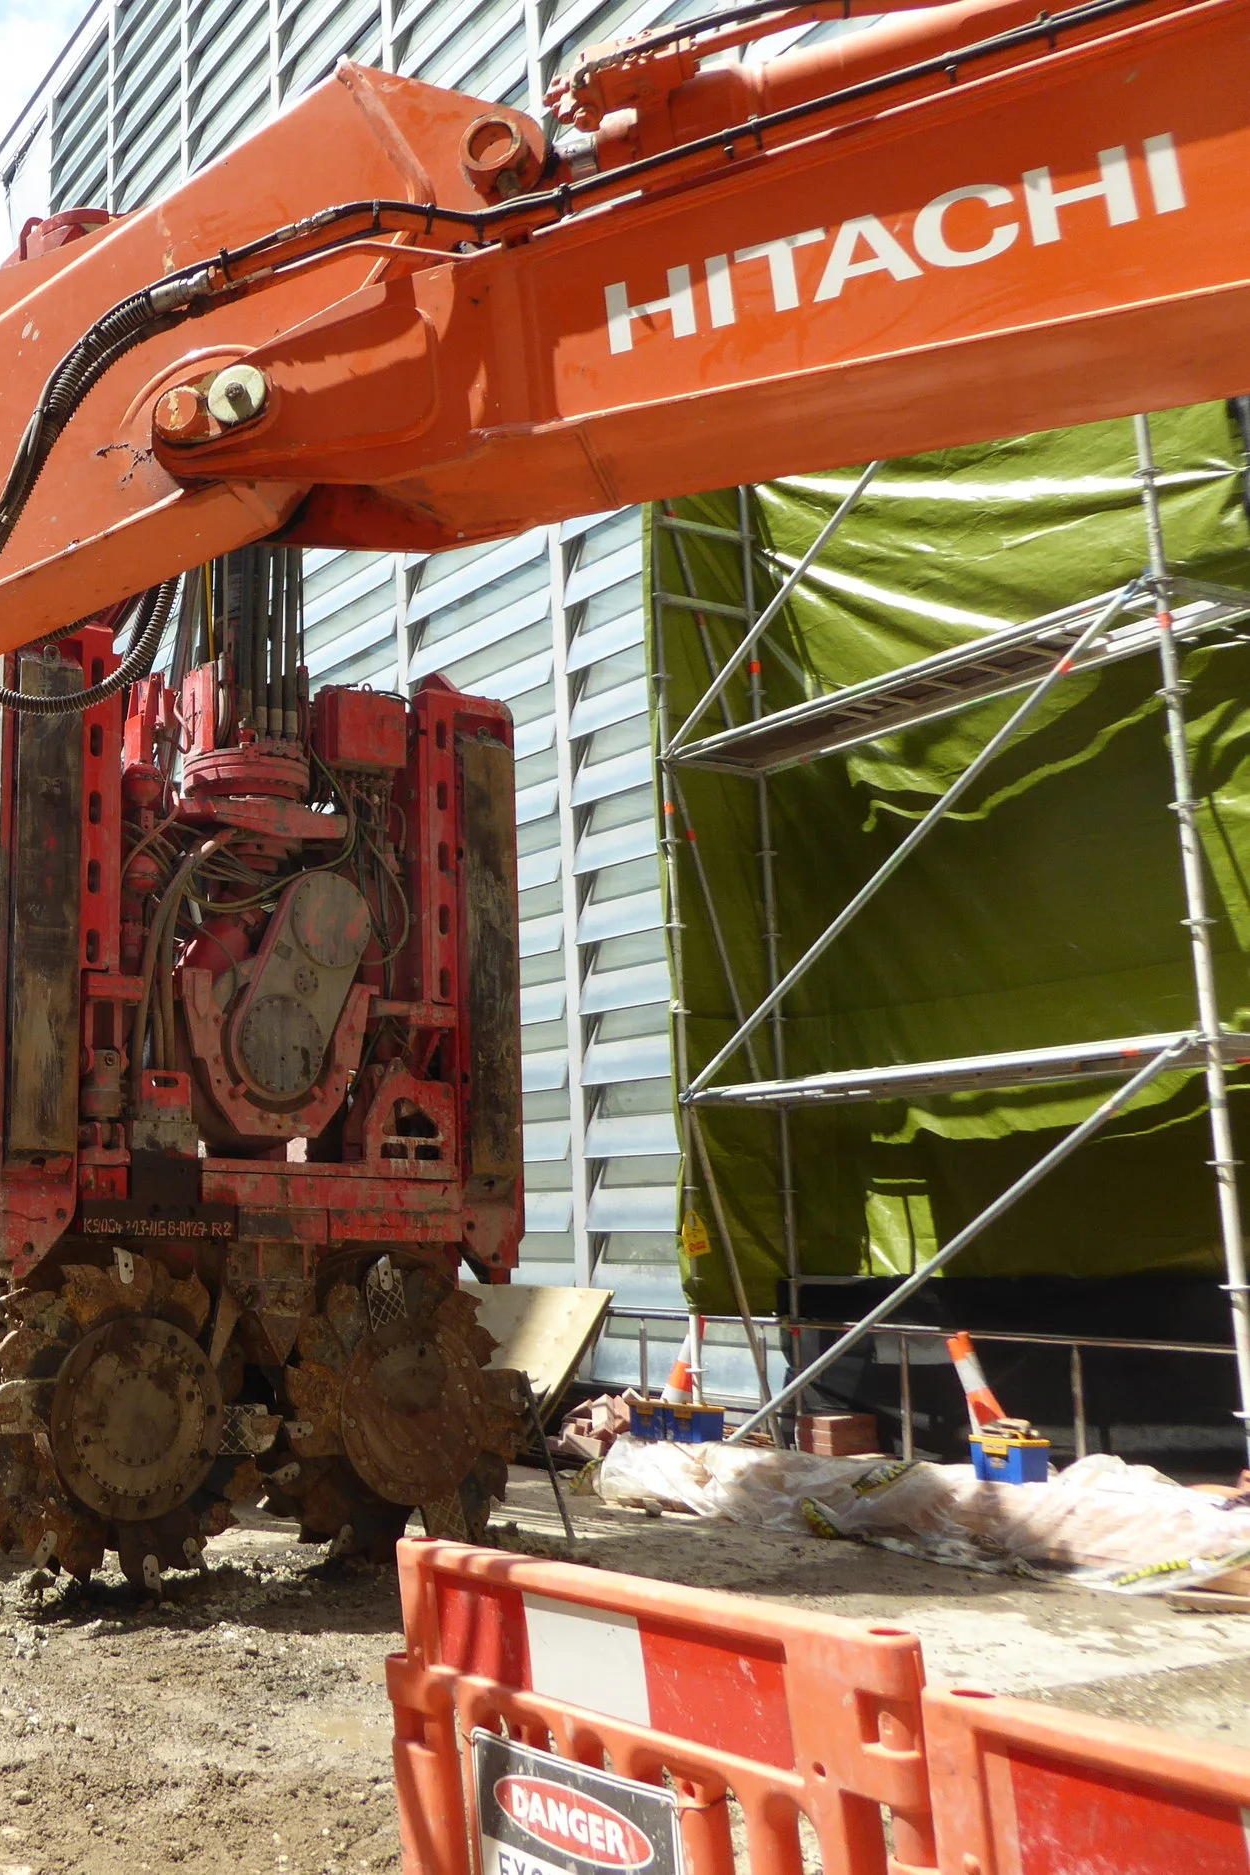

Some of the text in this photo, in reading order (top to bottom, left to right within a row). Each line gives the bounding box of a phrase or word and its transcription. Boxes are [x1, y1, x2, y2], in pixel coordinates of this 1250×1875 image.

[604, 132, 1186, 355] HITACHI
[211, 1221, 232, 1236] R2
[511, 1784, 629, 1864] DANGER
